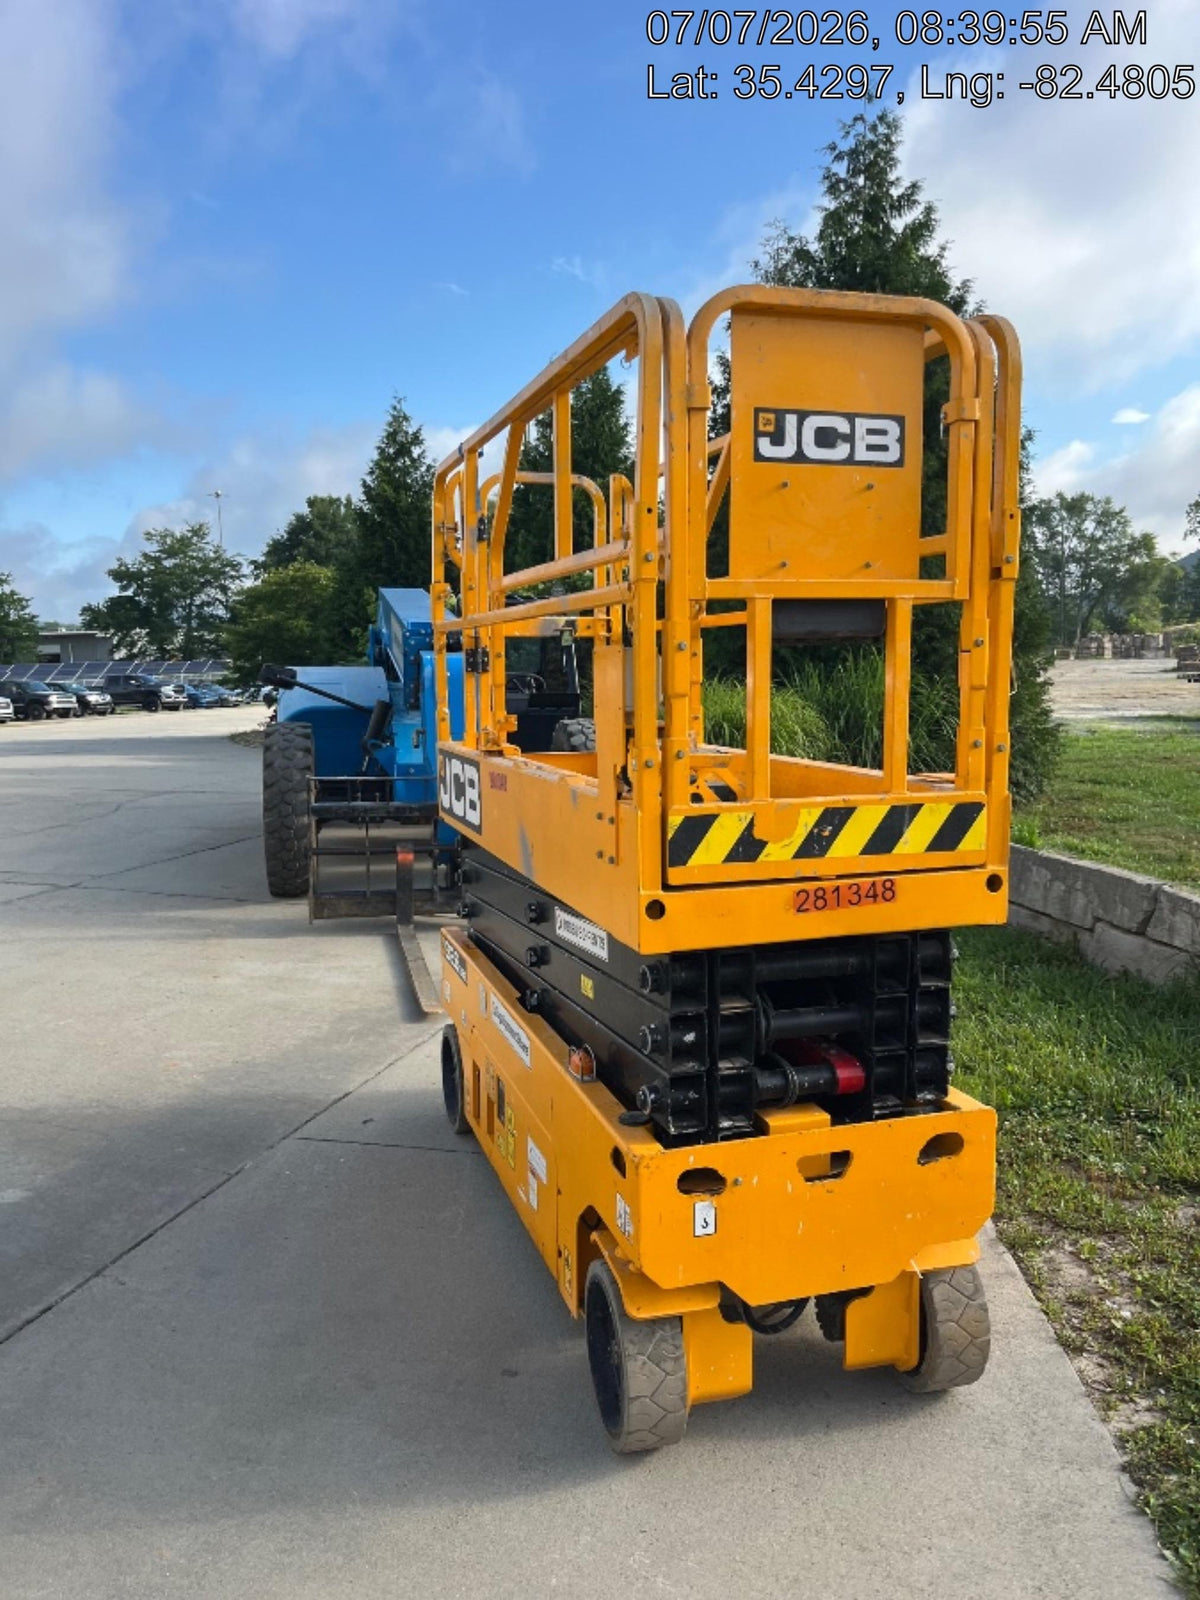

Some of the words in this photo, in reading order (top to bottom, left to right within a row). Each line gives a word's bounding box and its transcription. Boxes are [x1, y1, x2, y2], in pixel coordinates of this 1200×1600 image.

[757, 413, 900, 463] JCB
[440, 756, 480, 825] JCB
[796, 878, 895, 913] 281348
